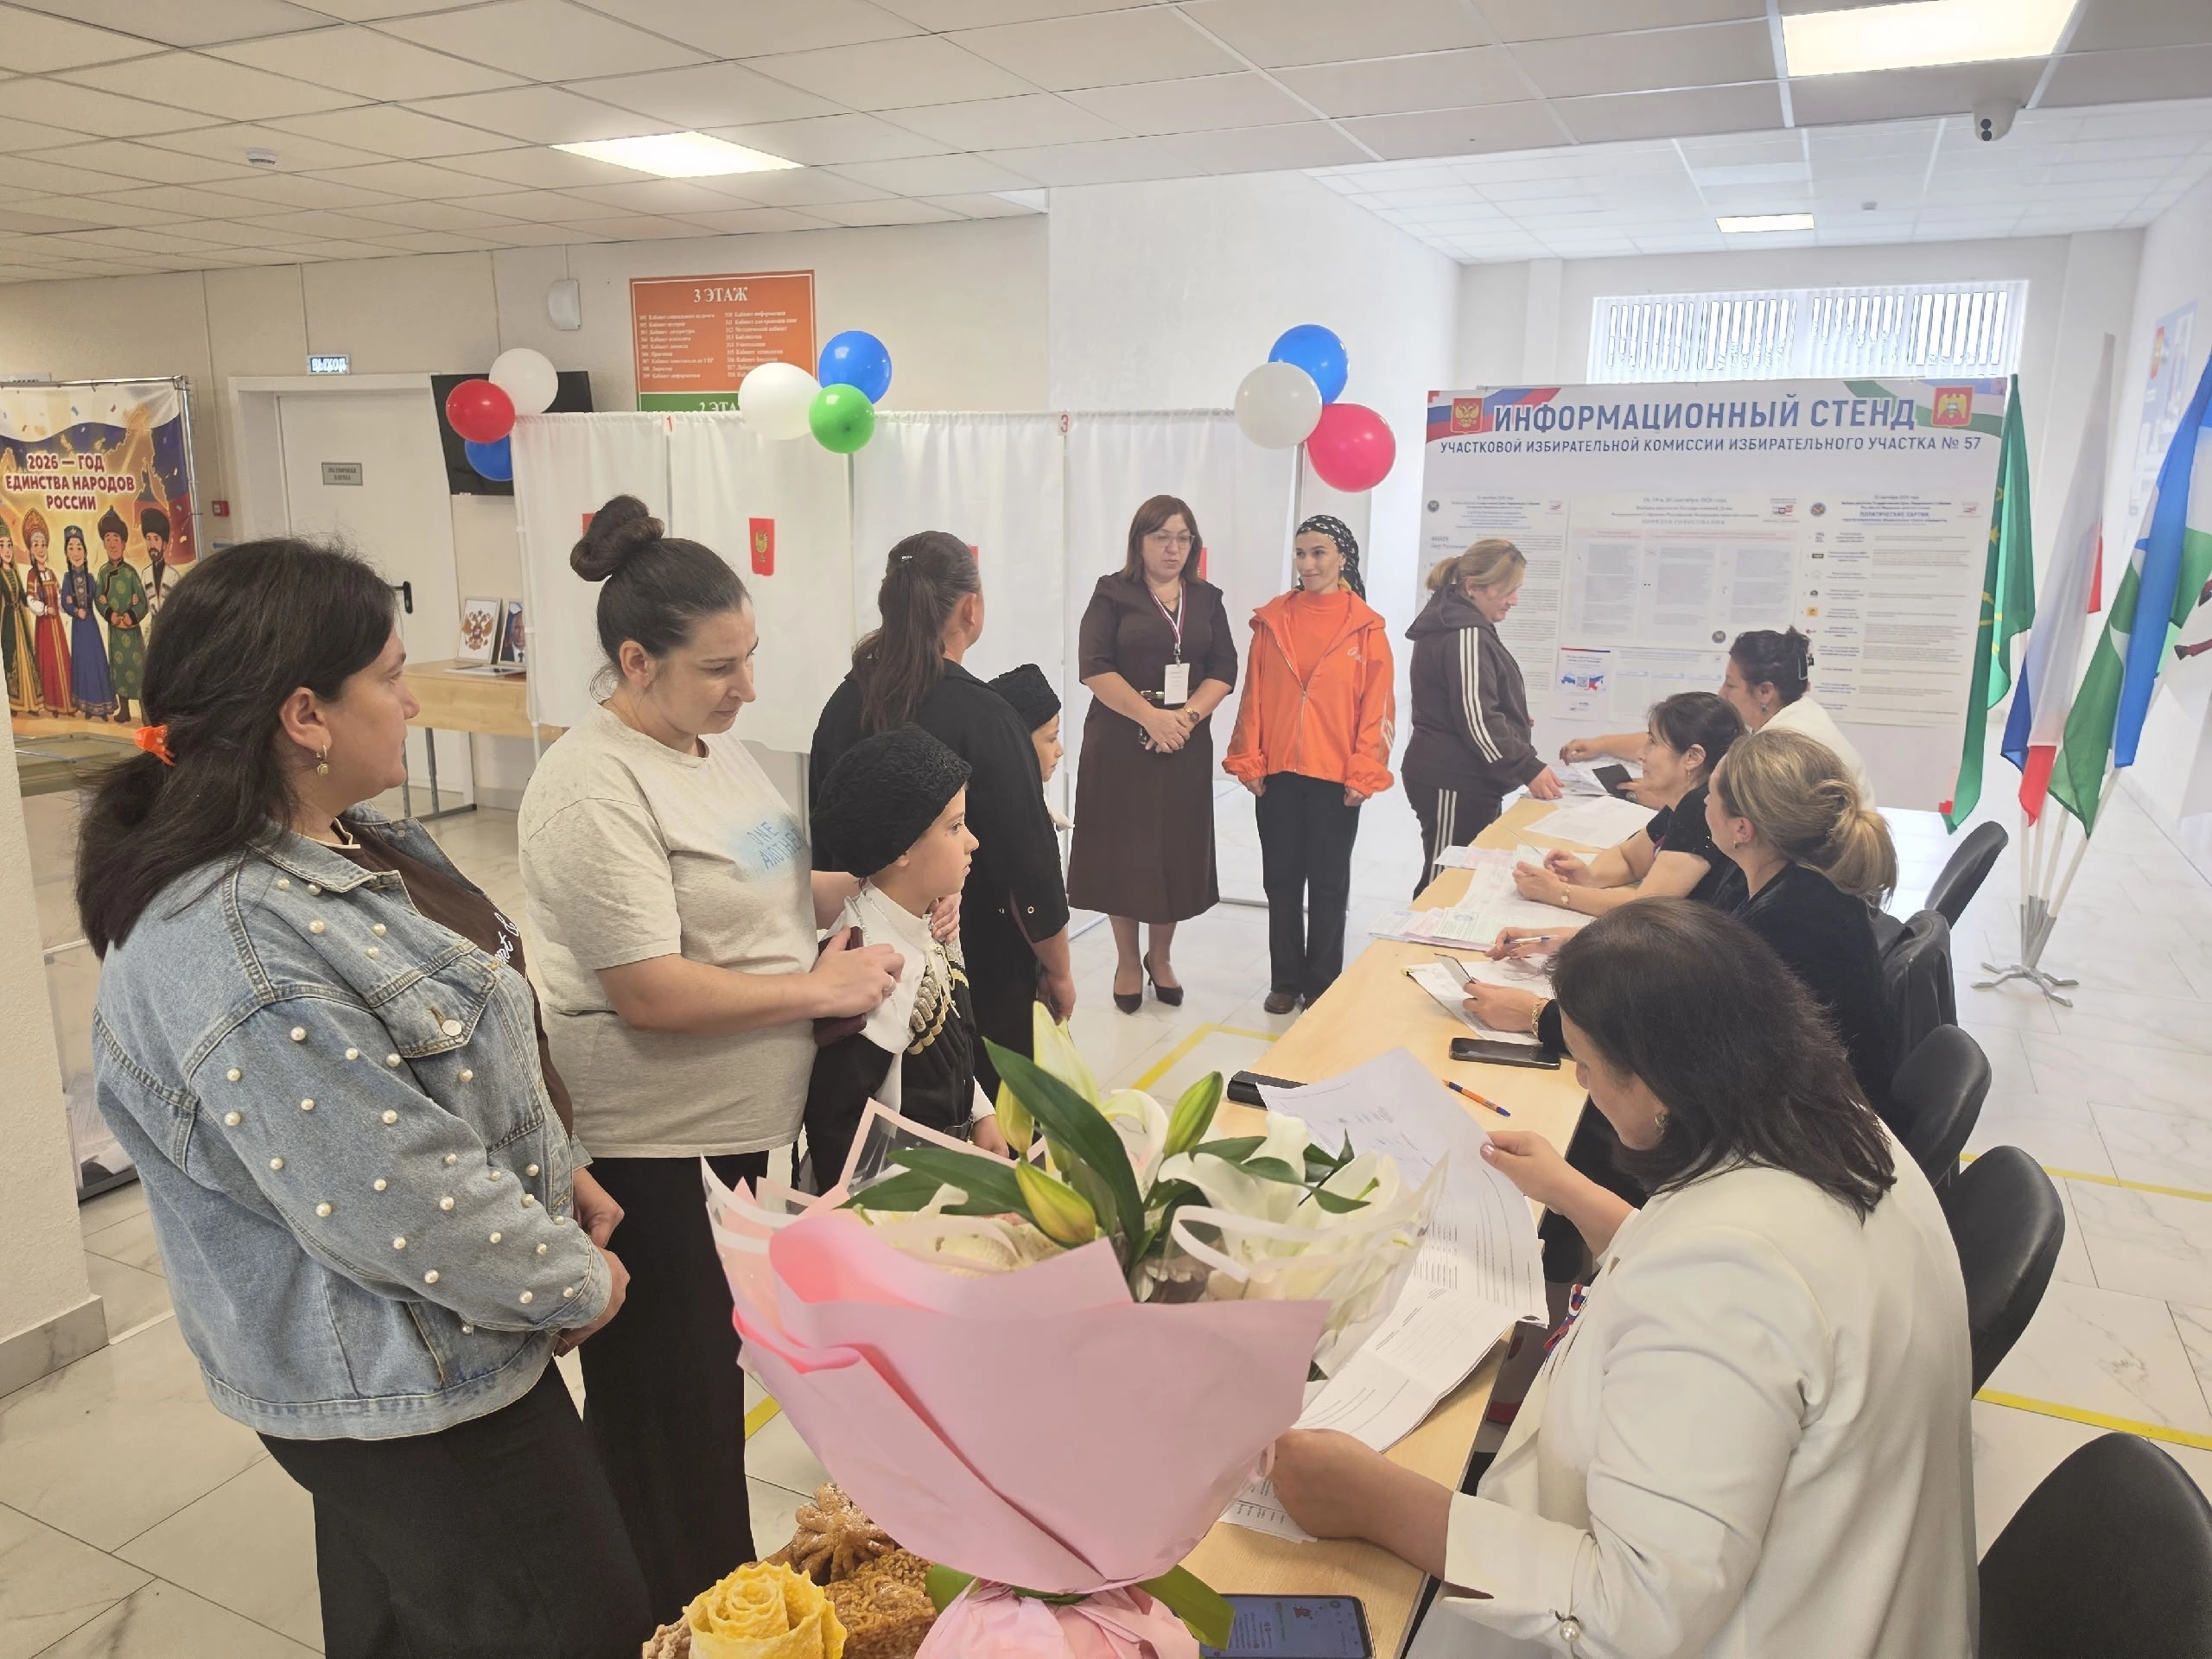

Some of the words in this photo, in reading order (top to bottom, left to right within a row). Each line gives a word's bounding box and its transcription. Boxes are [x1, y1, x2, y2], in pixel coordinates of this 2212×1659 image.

[693, 289, 701, 302] 3
[704, 287, 747, 302] ЭТАЖ
[312, 358, 347, 372] ВЫХОД
[709, 401, 740, 411] ЭТА
[1495, 394, 1799, 432] ИНФОРМАЦИОННЫЙ
[1811, 399, 1916, 431] СТЕНД
[666, 415, 672, 432] 1
[1060, 414, 1069, 433] 3
[1440, 438, 1522, 454] УЧАСТКОВОЙ
[1526, 437, 1639, 453] ИЗБИРАТЕЛЬНОЙ
[1643, 438, 1724, 452] КОМИССИИ
[1728, 437, 1864, 451] ИЗБИРАТЕЛЬНОГО
[1868, 436, 1936, 450] УЧАСТКА
[1942, 436, 1959, 449] №
[1964, 436, 1981, 449] 57
[27, 454, 59, 470] 2026
[78, 454, 105, 473] ГОД
[5, 475, 70, 492] ЕДИНСТВА
[72, 476, 136, 493] НАРОДОВ
[46, 494, 97, 510] РОССИИ
[747, 821, 780, 846] ONE
